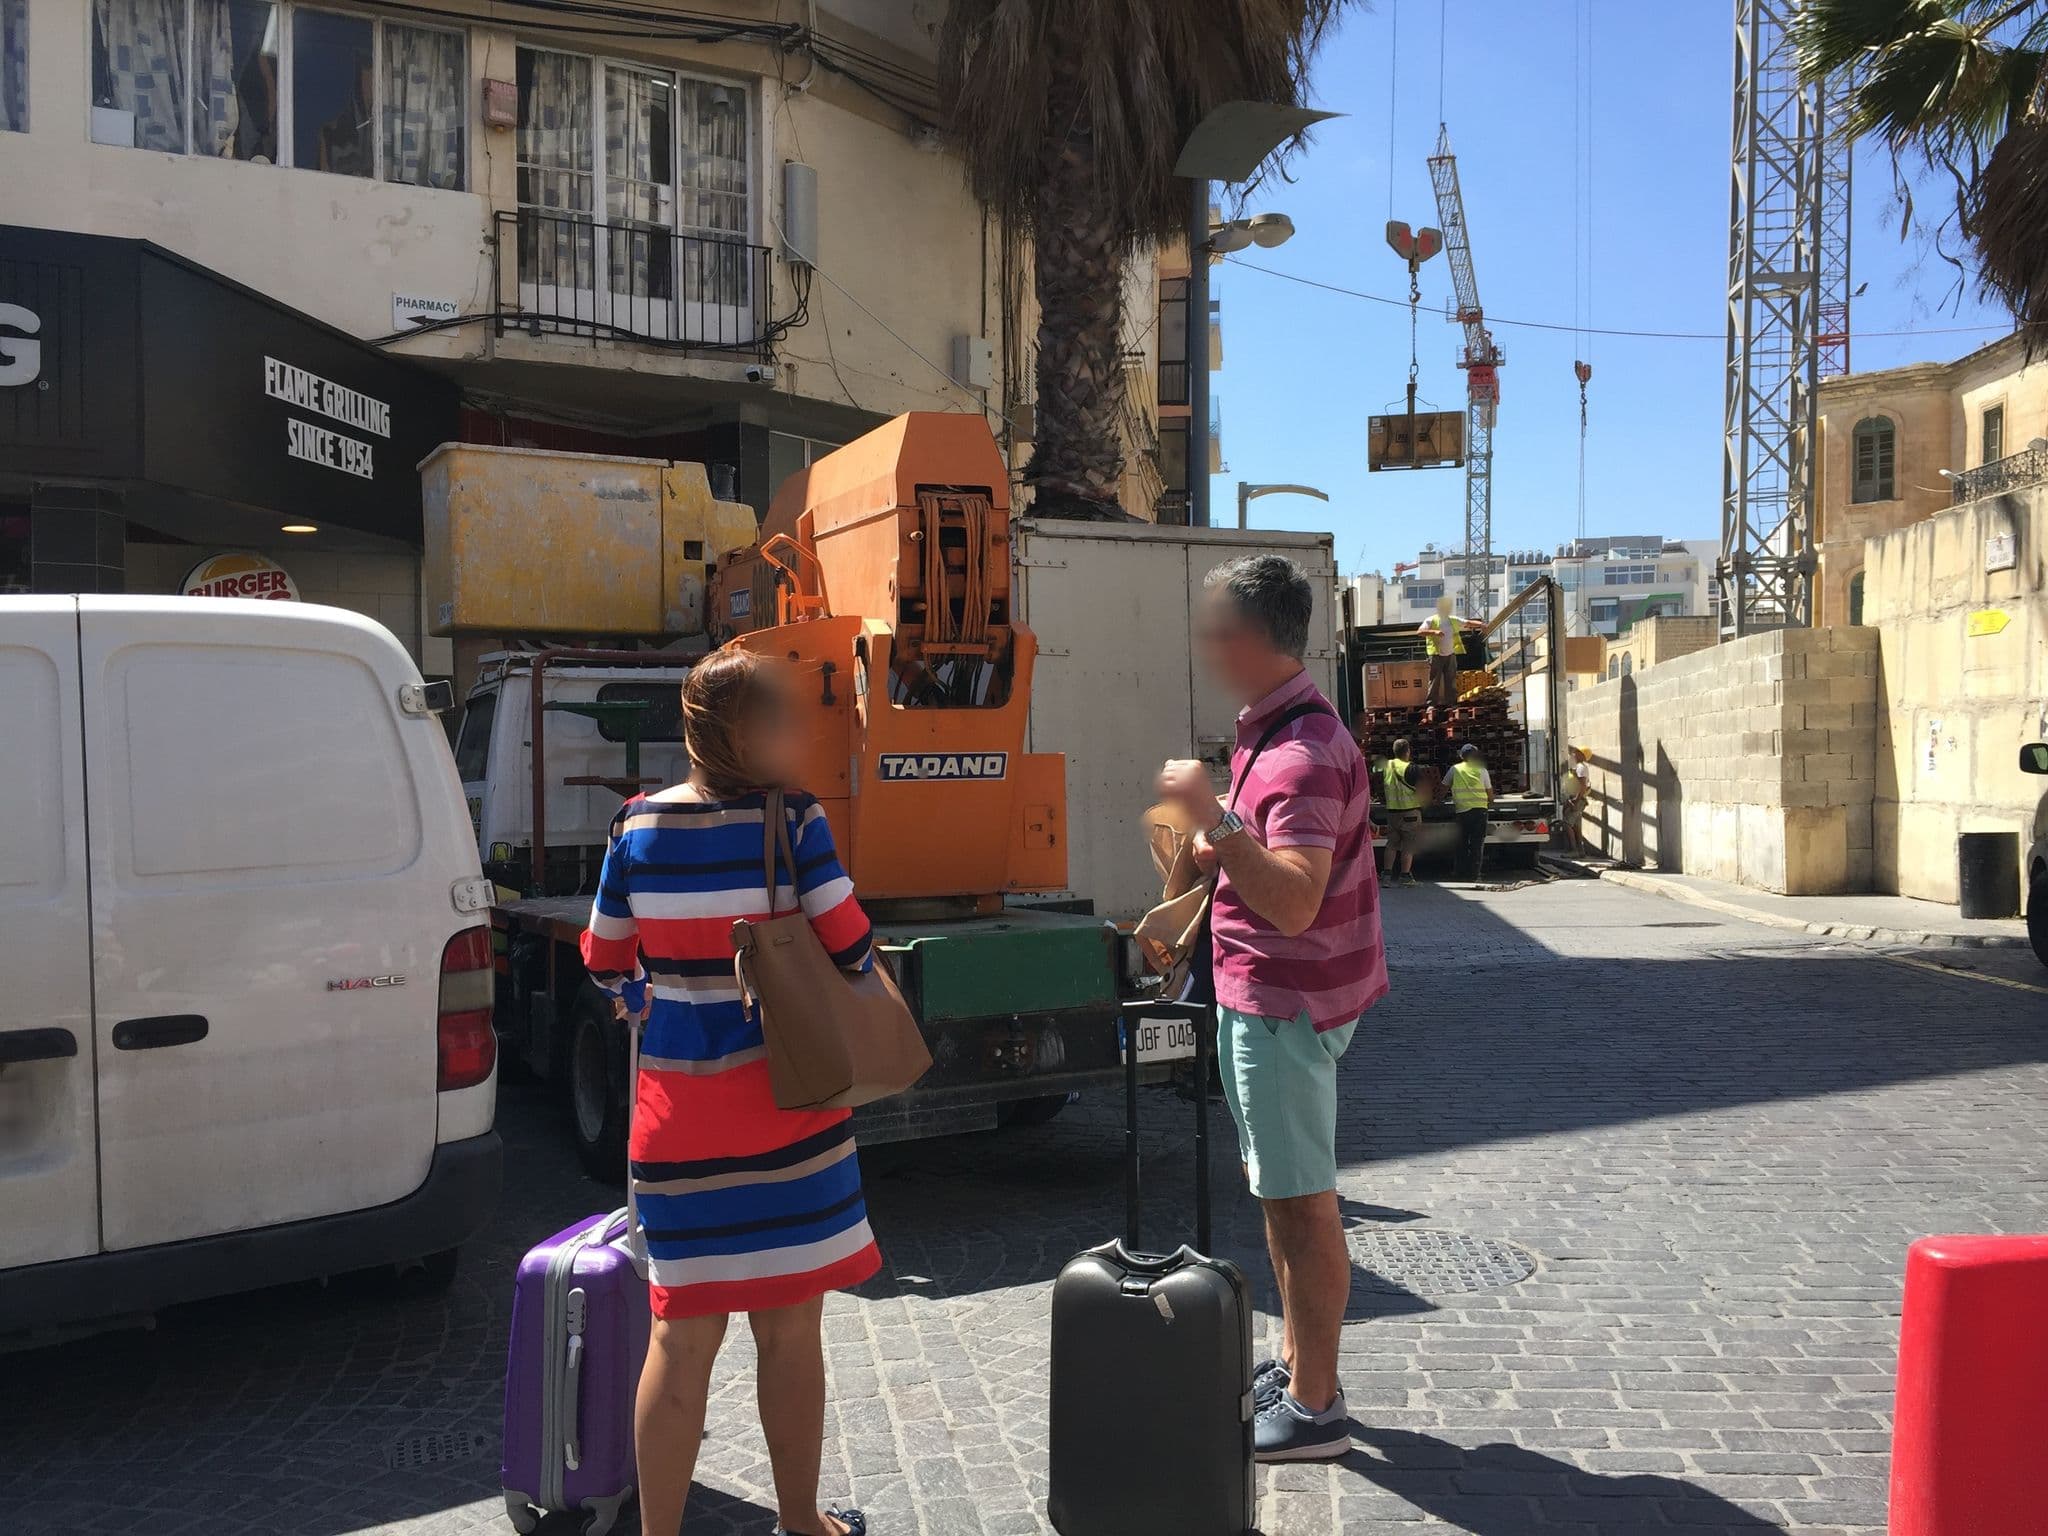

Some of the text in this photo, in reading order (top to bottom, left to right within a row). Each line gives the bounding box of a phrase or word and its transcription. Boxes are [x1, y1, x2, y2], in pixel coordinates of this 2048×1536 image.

[395, 297, 457, 314] PHARMACY
[264, 355, 391, 439] FLAME GRILLING
[287, 417, 374, 480] SINCE 1954
[883, 756, 1003, 777] TADANO
[327, 975, 406, 992] HIACE
[1137, 1026, 1161, 1052] JBF
